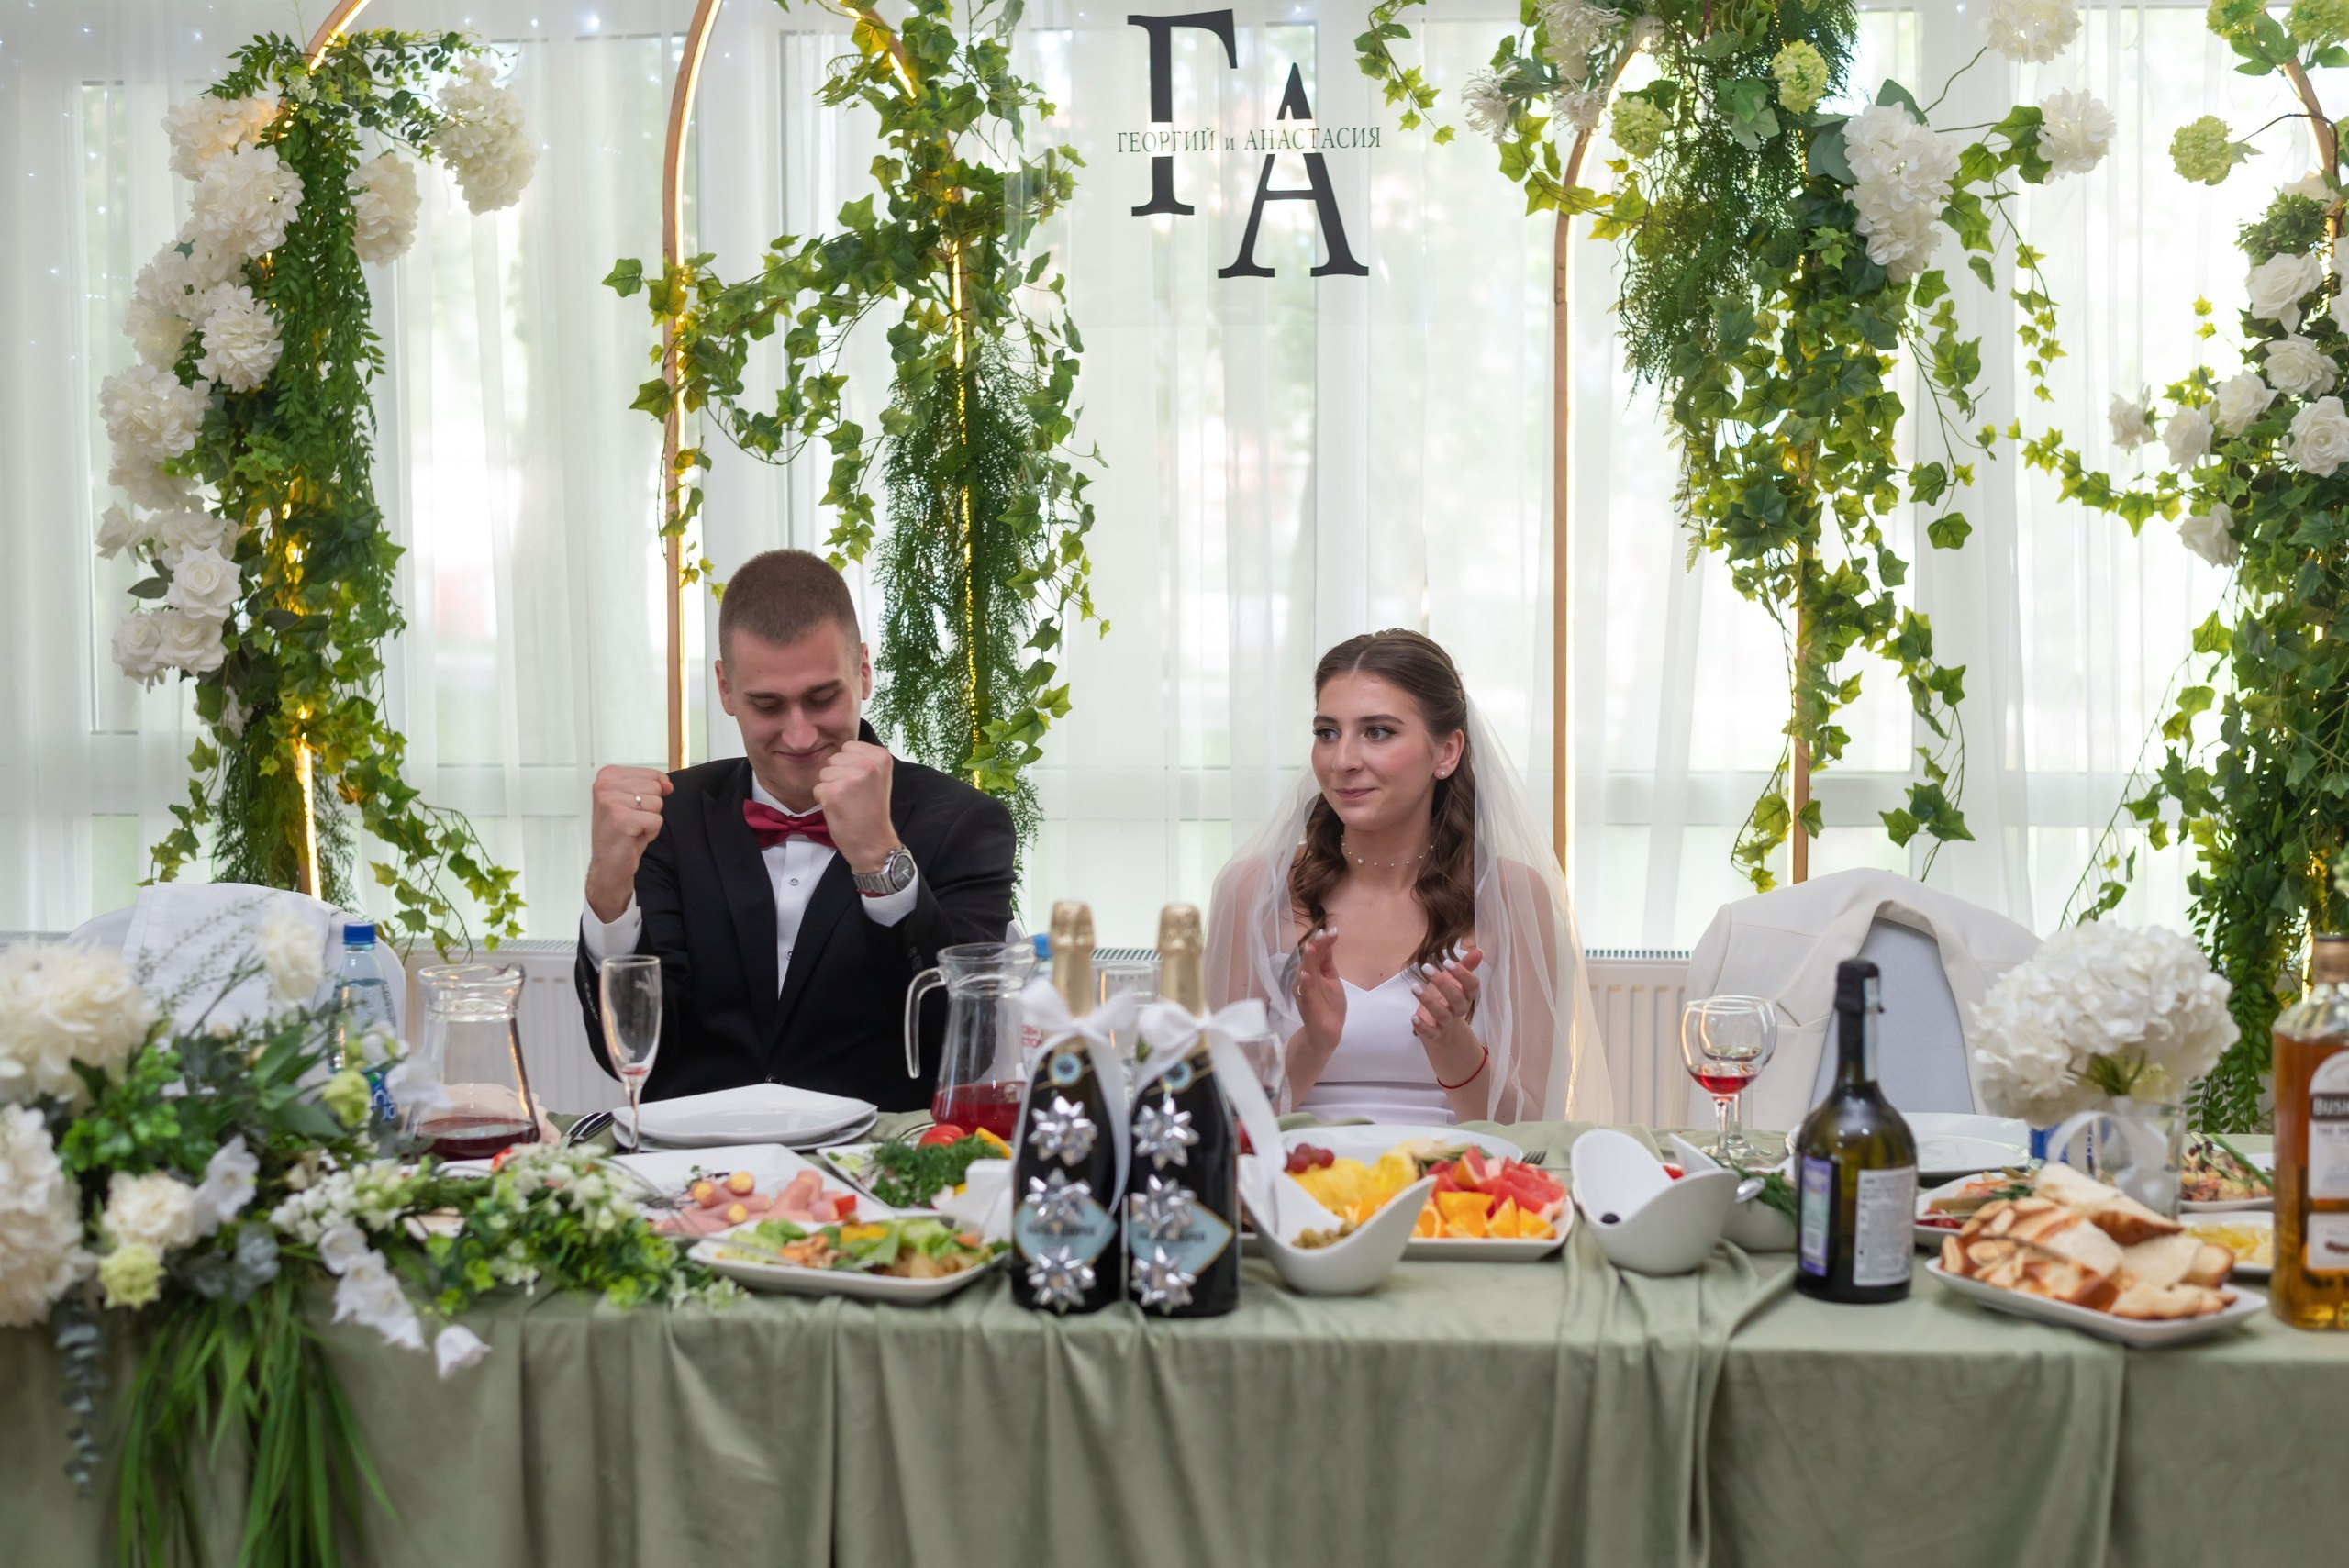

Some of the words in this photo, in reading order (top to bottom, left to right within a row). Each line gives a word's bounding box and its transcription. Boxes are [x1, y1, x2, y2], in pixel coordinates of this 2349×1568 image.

[1117, 127, 1215, 153] ГЕОРГИЙ
[1225, 137, 1235, 150] и
[1243, 127, 1382, 150] АНАСТАСИЯ
[1127, 9, 1238, 217] Г
[1218, 62, 1369, 279] А
